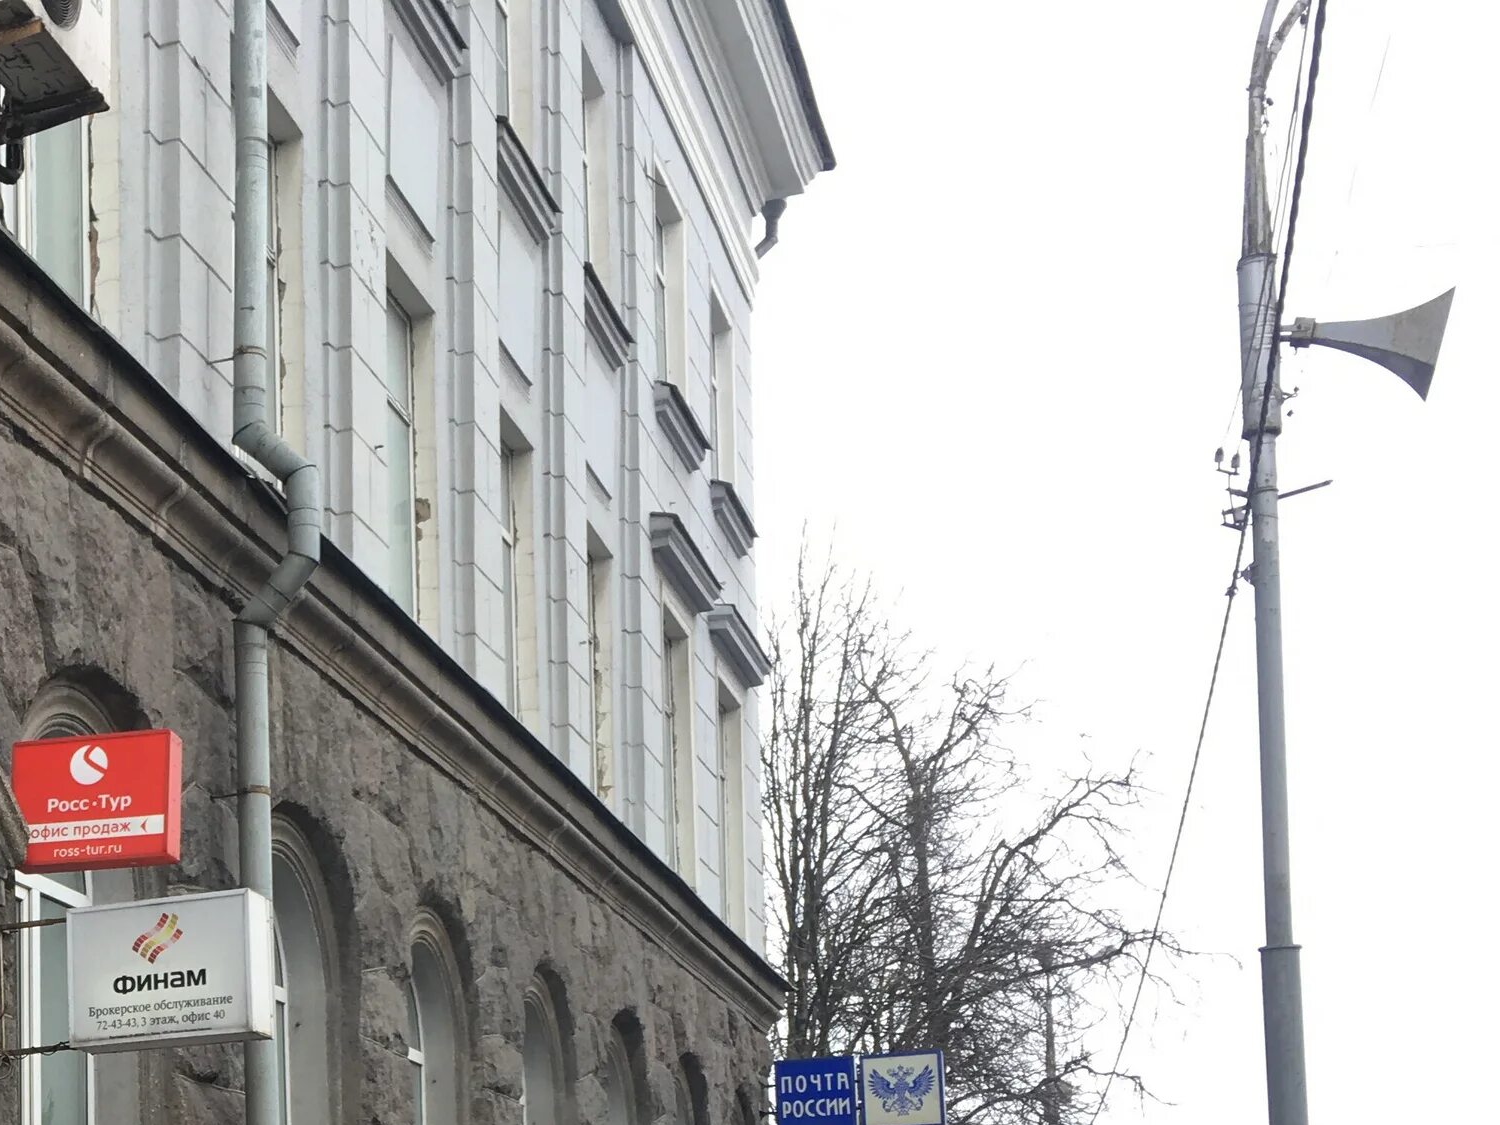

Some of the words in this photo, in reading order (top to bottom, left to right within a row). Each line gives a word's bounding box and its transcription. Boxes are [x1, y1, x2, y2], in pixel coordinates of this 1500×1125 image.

[30, 826, 69, 840] офис
[73, 822, 131, 838] продаж
[53, 844, 122, 858] ross-tur.ru
[88, 1003, 151, 1019] Брокерское
[153, 994, 233, 1011] обслуживание
[97, 1017, 139, 1031] 72-43-43,
[140, 1017, 147, 1027] 3
[149, 1015, 179, 1026] этаж,
[181, 1011, 211, 1024] офис
[213, 1009, 225, 1020] 40
[780, 1072, 850, 1094] ПОЧТА
[782, 1097, 851, 1119] РОССИИ
